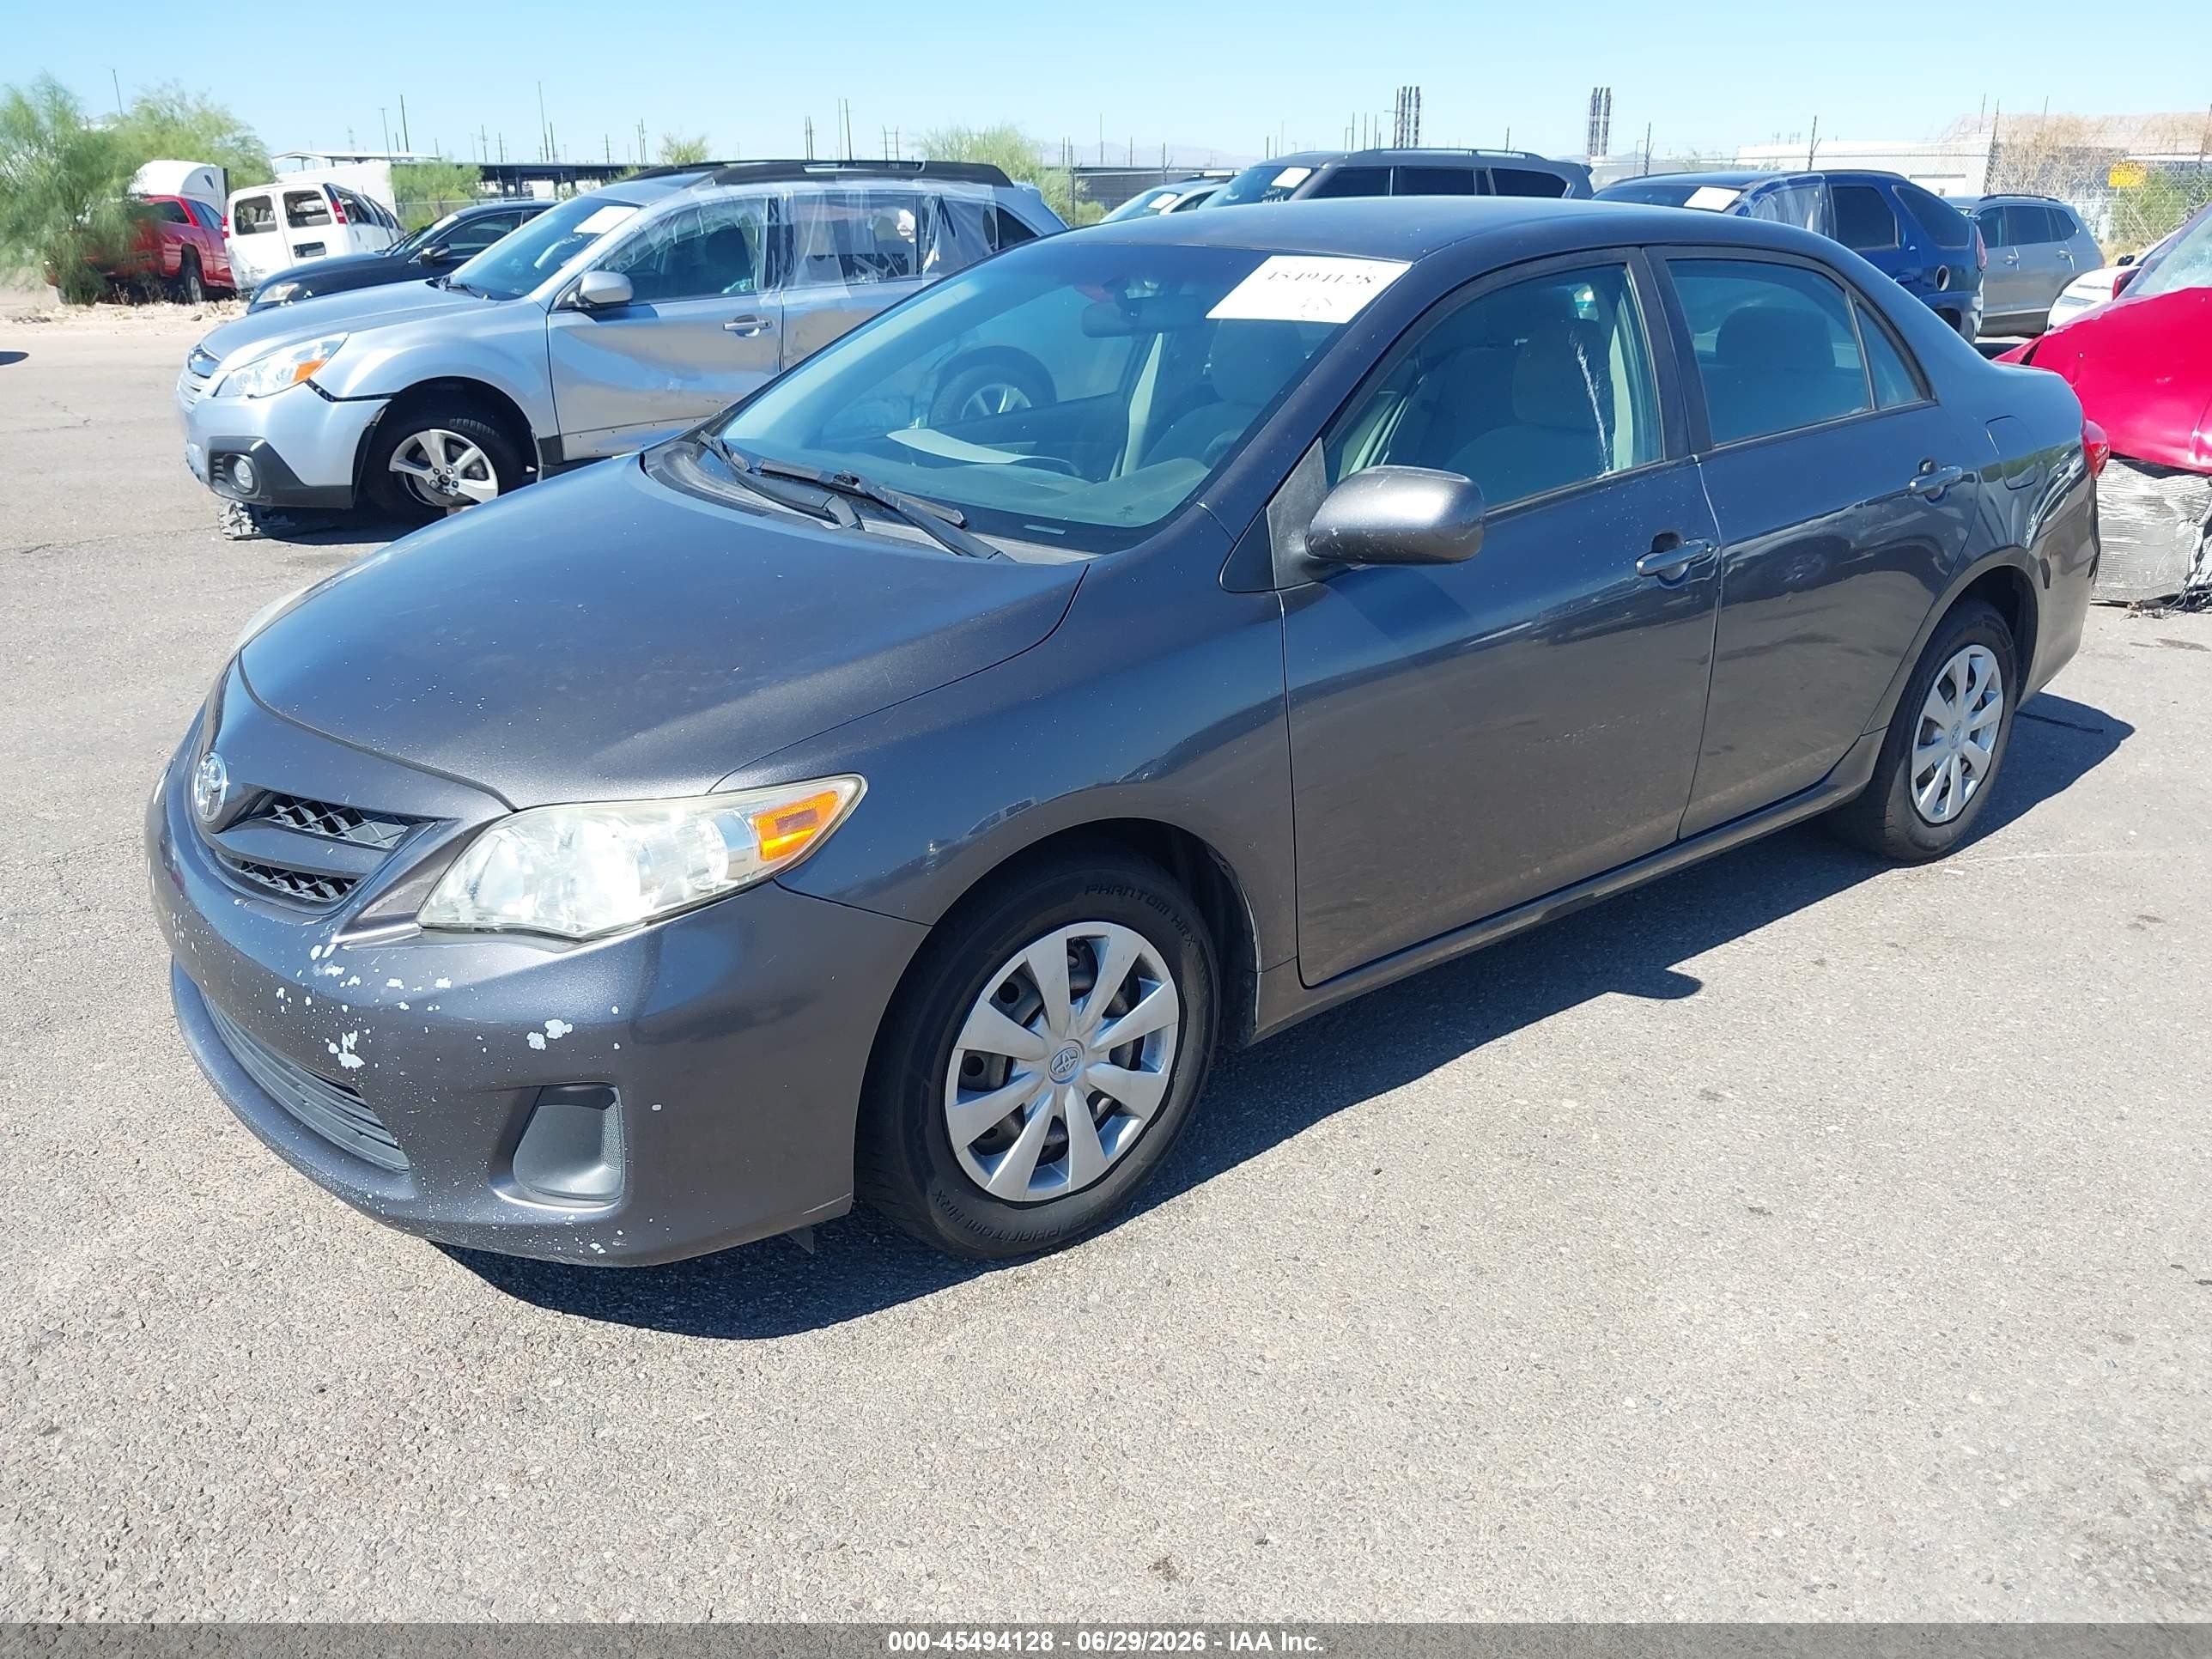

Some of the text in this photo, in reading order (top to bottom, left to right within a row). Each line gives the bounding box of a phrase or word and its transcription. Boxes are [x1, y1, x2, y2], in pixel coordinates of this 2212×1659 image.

[1085, 884, 1196, 948] PHANTOM HRX
[964, 1218, 1063, 1243] PHANTOM
